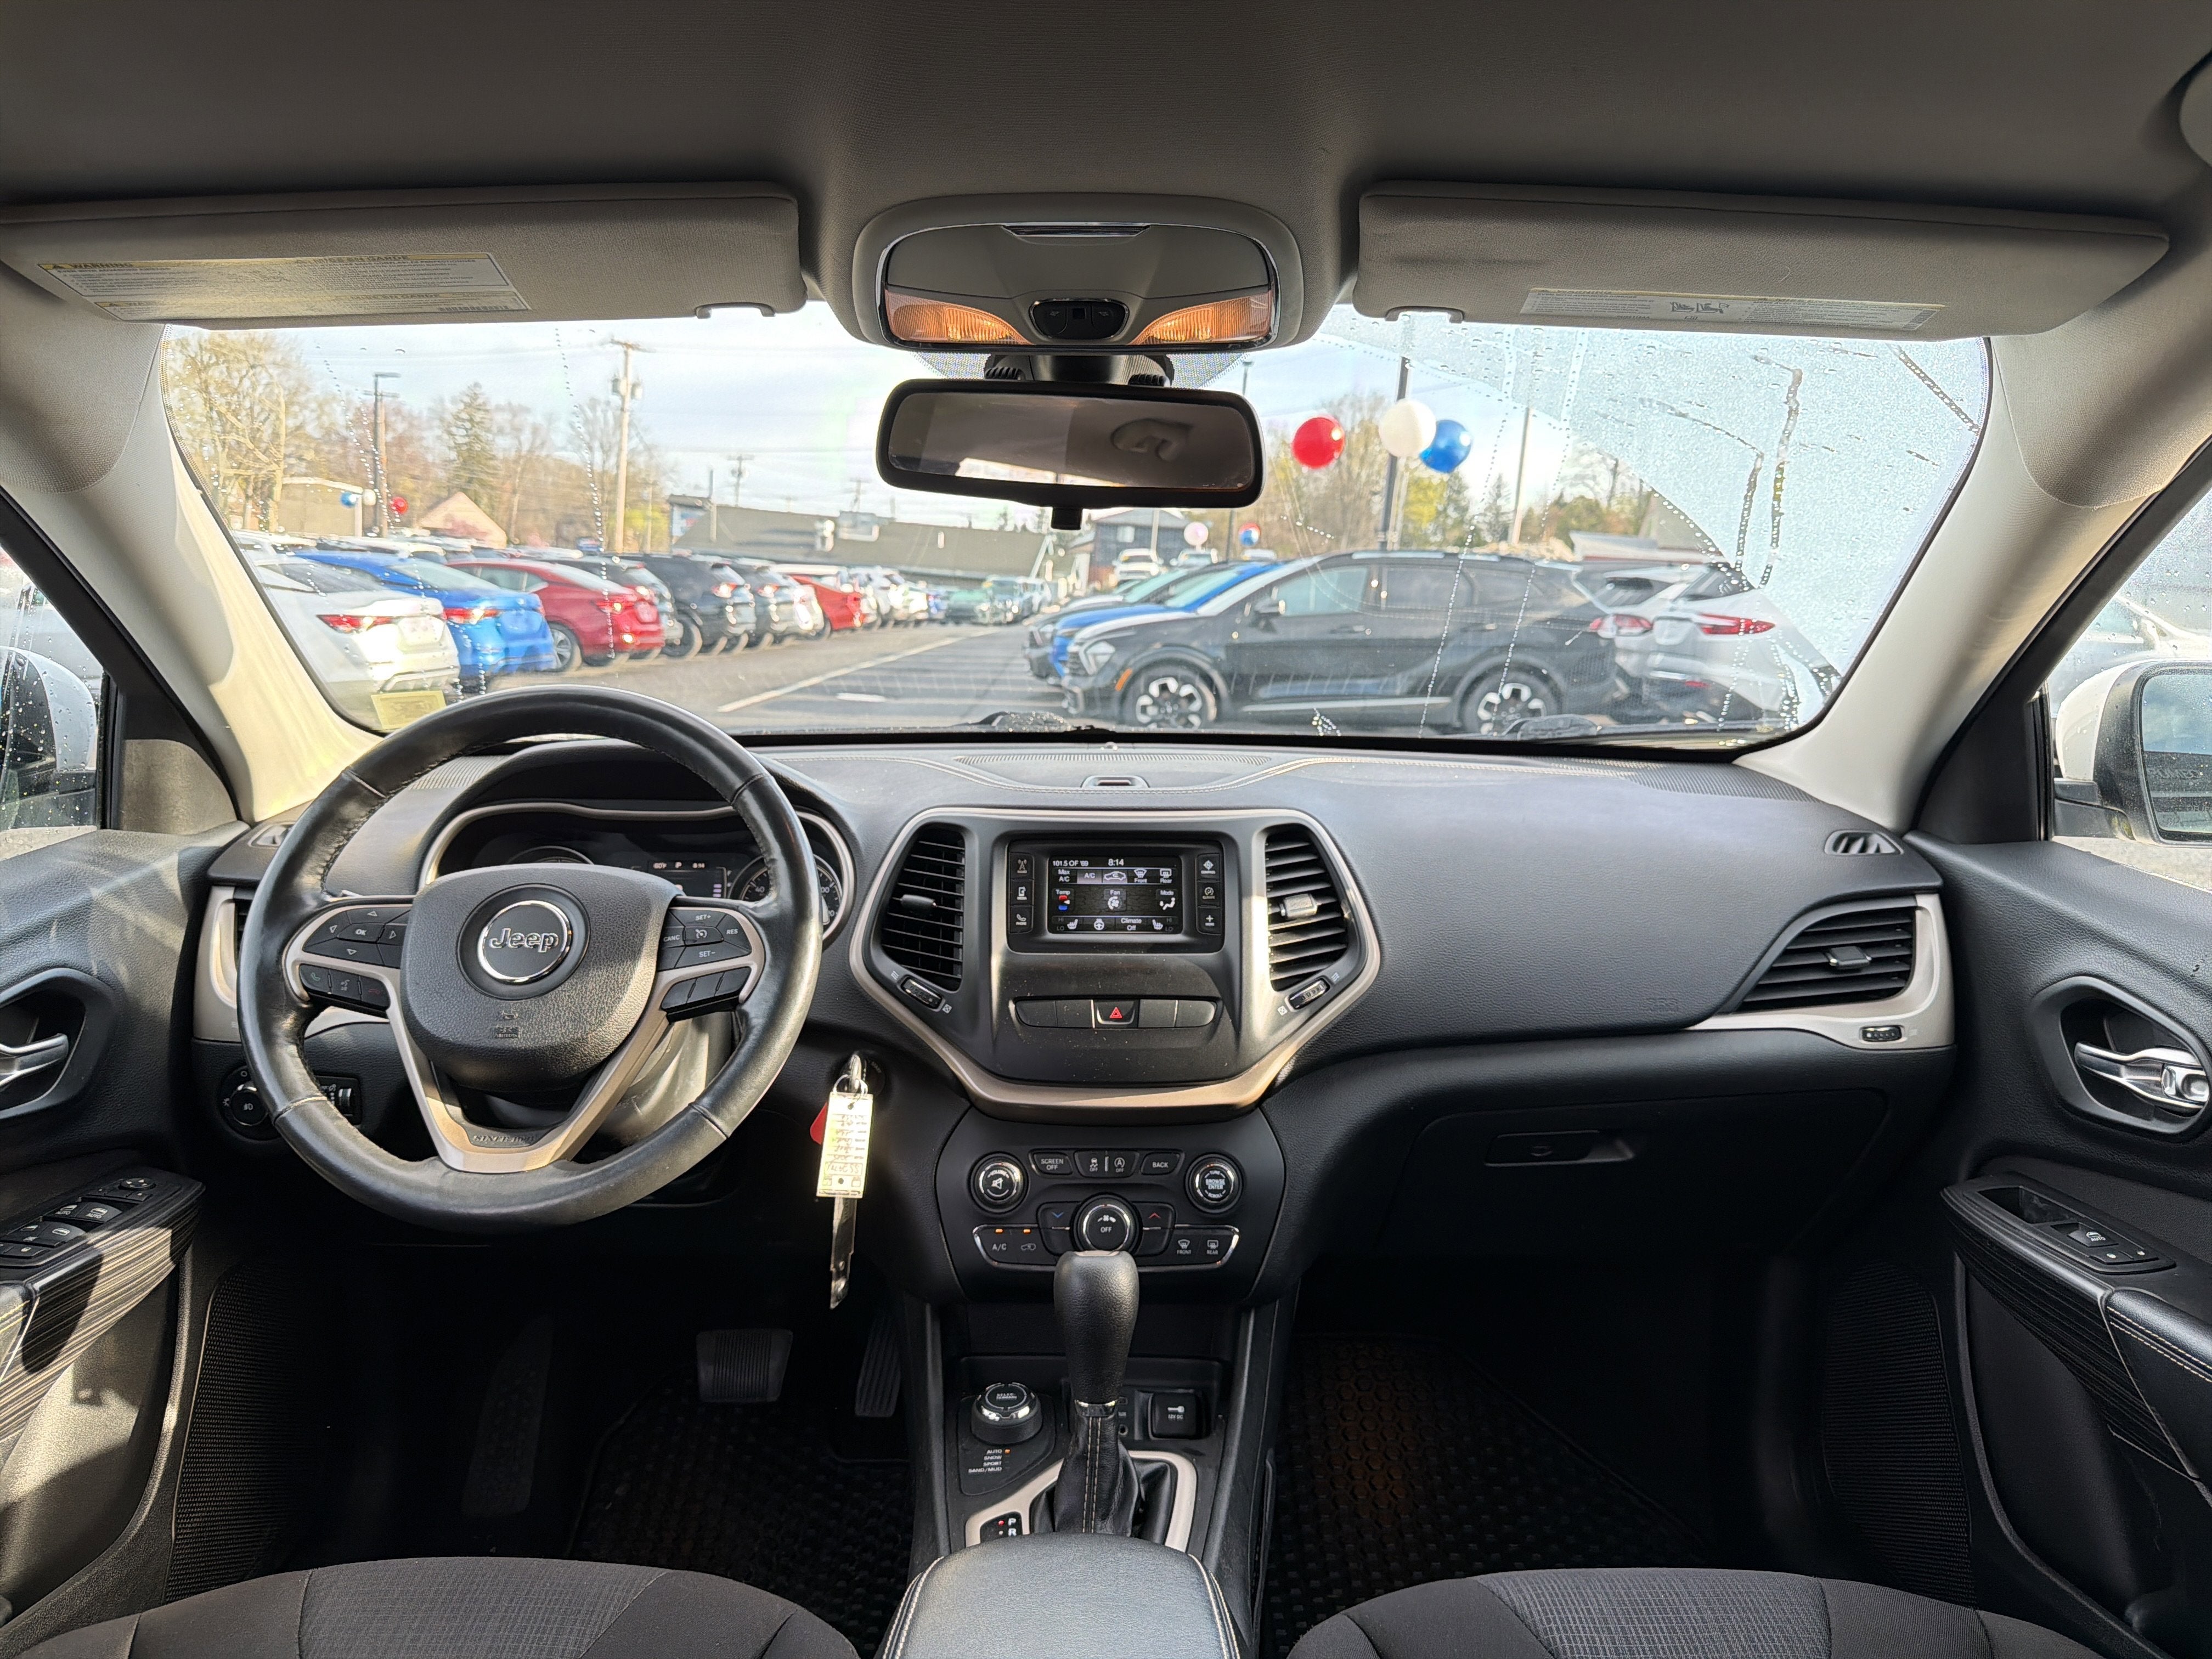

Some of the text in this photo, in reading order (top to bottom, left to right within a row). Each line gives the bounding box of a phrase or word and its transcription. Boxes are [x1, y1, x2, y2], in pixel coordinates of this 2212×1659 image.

[489, 928, 559, 953] Jeep
[992, 1243, 1007, 1251] A/C
[1008, 1517, 1017, 1526] P
[1008, 1528, 1017, 1536] R
